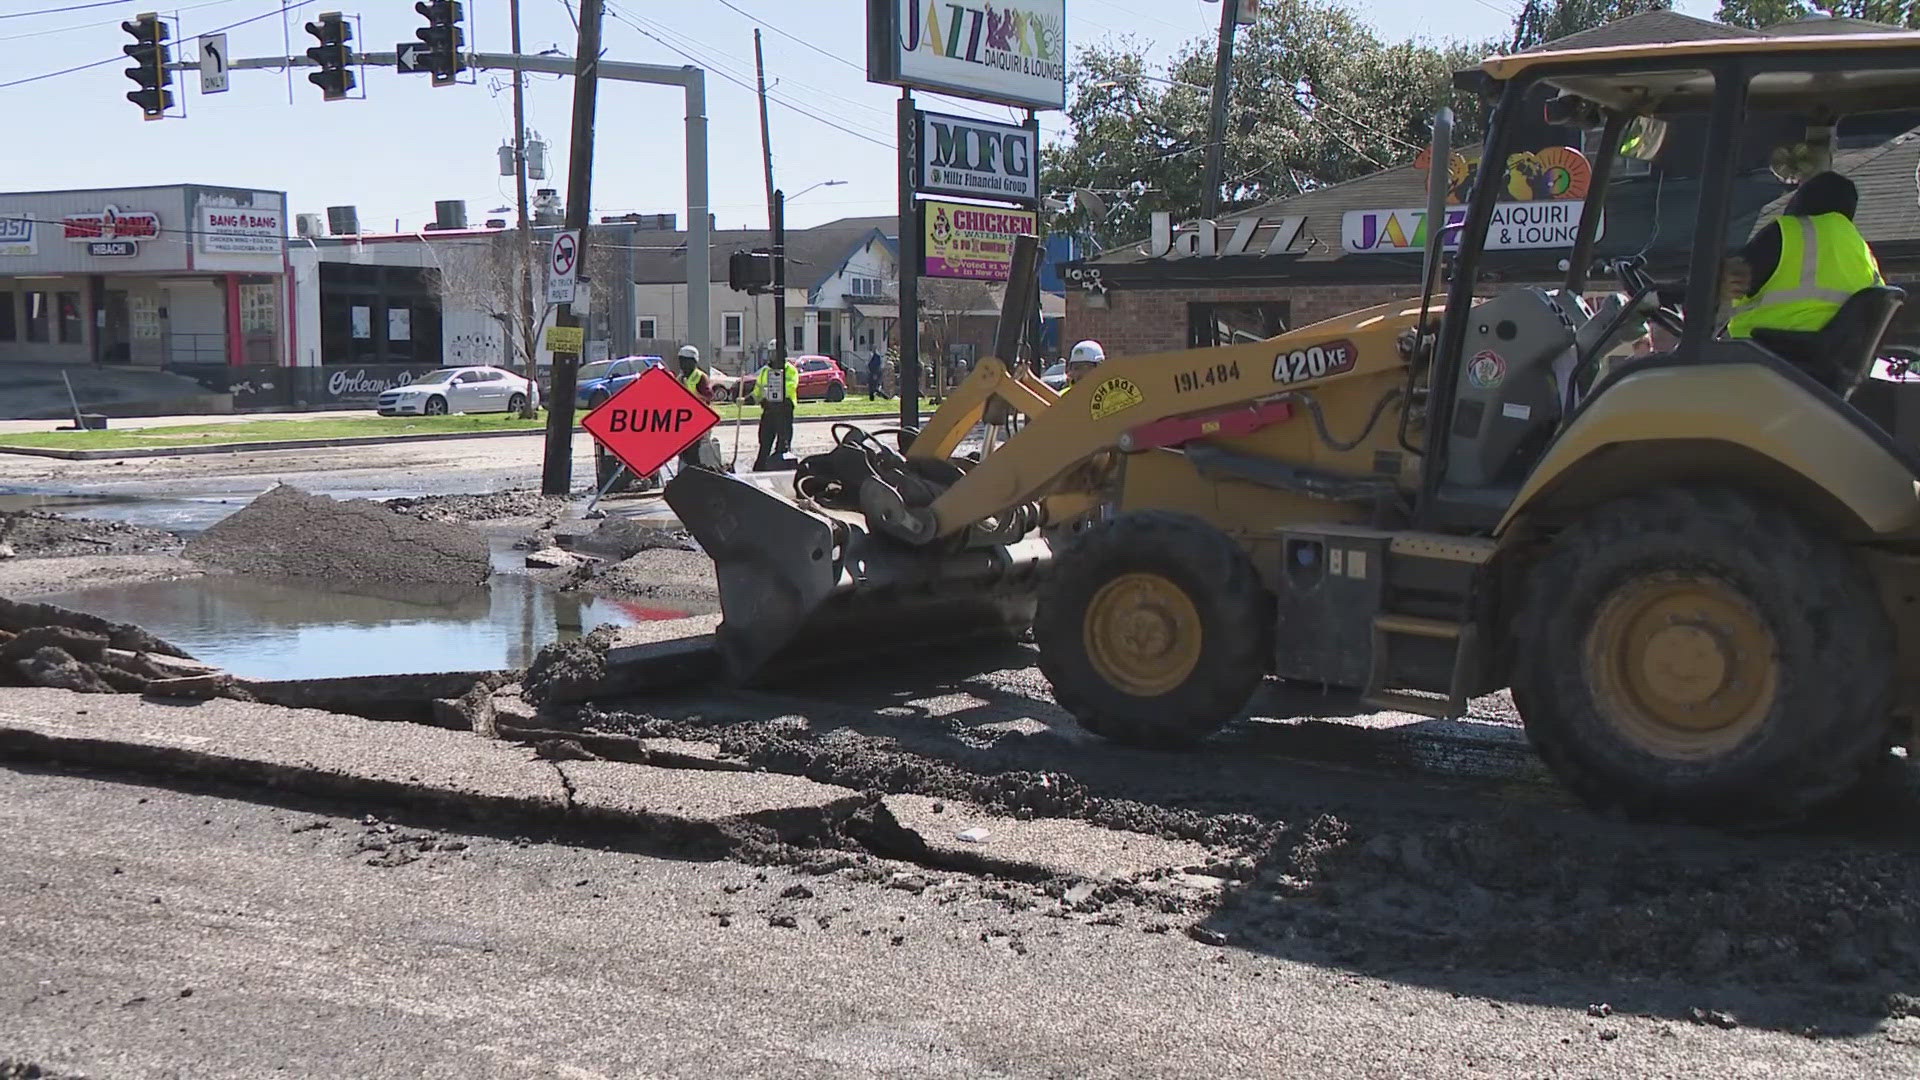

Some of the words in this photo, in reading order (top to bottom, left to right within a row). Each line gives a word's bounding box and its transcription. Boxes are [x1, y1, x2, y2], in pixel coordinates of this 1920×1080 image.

[900, 0, 984, 64] JAZZ
[985, 50, 1022, 72] DAIQUIRI
[1023, 62, 1029, 74] &
[1031, 62, 1063, 82] LOUNGE
[205, 76, 225, 88] ONLY
[930, 122, 1028, 178] MFG
[943, 170, 963, 186] Millz
[965, 173, 1001, 190] Financial
[1003, 179, 1027, 194] Group
[210, 214, 238, 227] BANG
[249, 216, 276, 228] BANG
[953, 210, 1032, 235] CHICKEN
[1491, 205, 1568, 227] AIQUIRI
[1136, 211, 1328, 259] Jazz
[1500, 228, 1511, 244] &
[92, 244, 126, 254] HIBACHI
[961, 261, 986, 270] Voted
[976, 268, 992, 276] New
[1174, 360, 1240, 393] 191.484
[1092, 385, 1107, 409] BOH
[610, 408, 693, 433] BUMP
